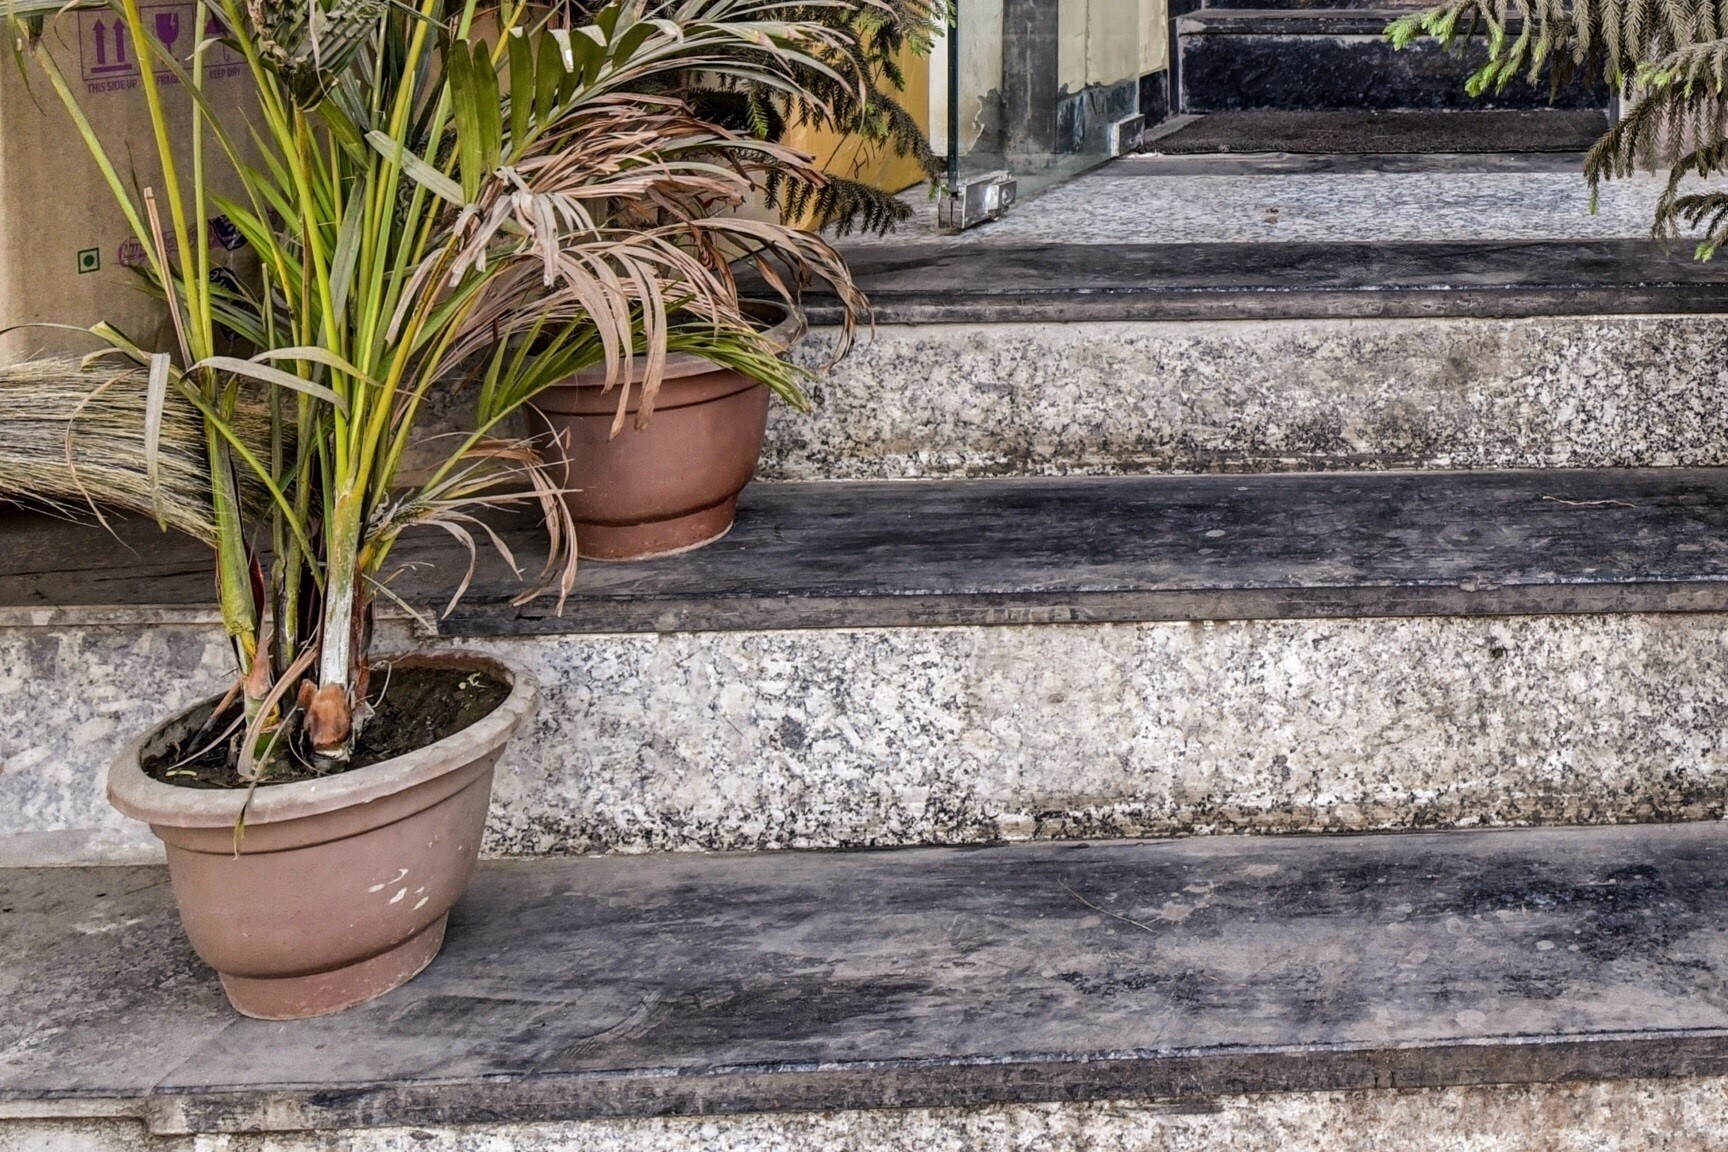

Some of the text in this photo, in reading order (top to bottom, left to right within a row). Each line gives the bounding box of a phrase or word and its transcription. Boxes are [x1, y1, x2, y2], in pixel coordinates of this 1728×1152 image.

[156, 73, 181, 86] FRAG
[87, 79, 138, 95] THIS SIDE UP
